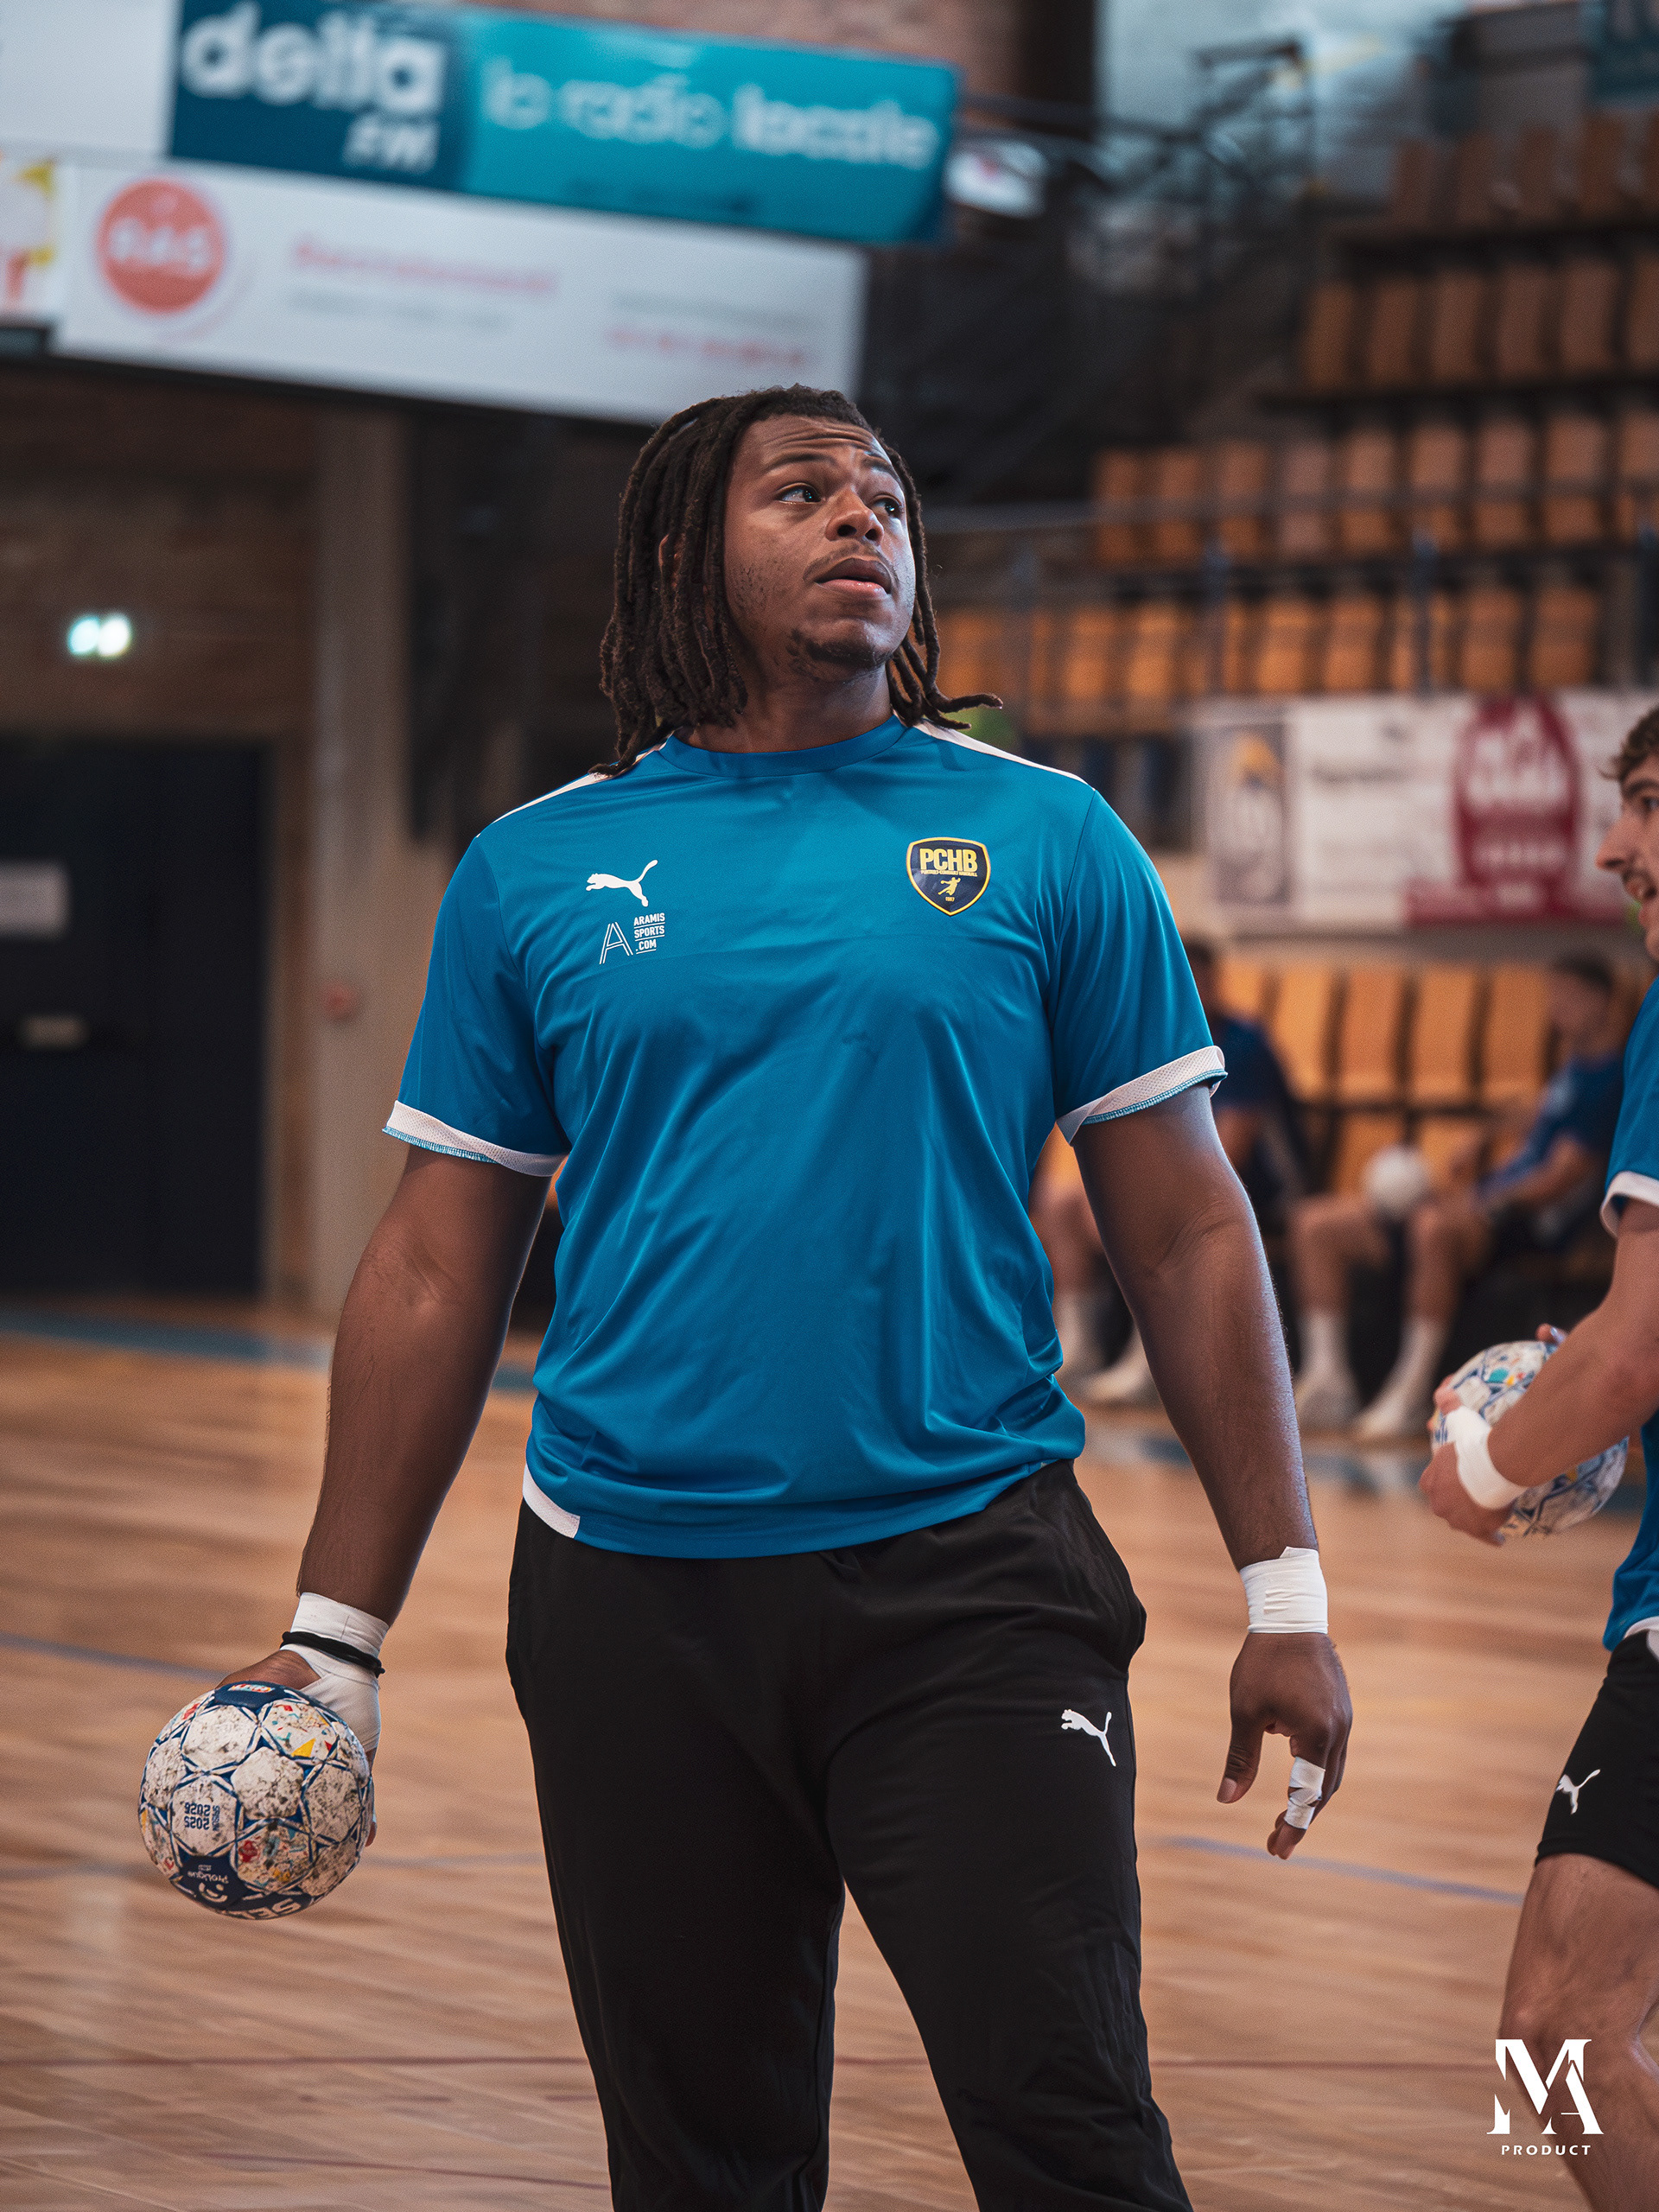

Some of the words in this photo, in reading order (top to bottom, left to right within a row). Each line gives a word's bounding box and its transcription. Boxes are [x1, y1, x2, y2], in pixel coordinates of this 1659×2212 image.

[181, 0, 444, 112] delta
[481, 56, 551, 130] la
[558, 73, 728, 149] radio
[732, 85, 939, 169] locale
[919, 849, 978, 873] PCHB
[633, 912, 665, 926] ARAMIS
[633, 925, 664, 939] SPORTS
[599, 921, 633, 964] A
[635, 938, 657, 951] .COM
[184, 1802, 211, 1817] 2026
[184, 1815, 210, 1831] 2025
